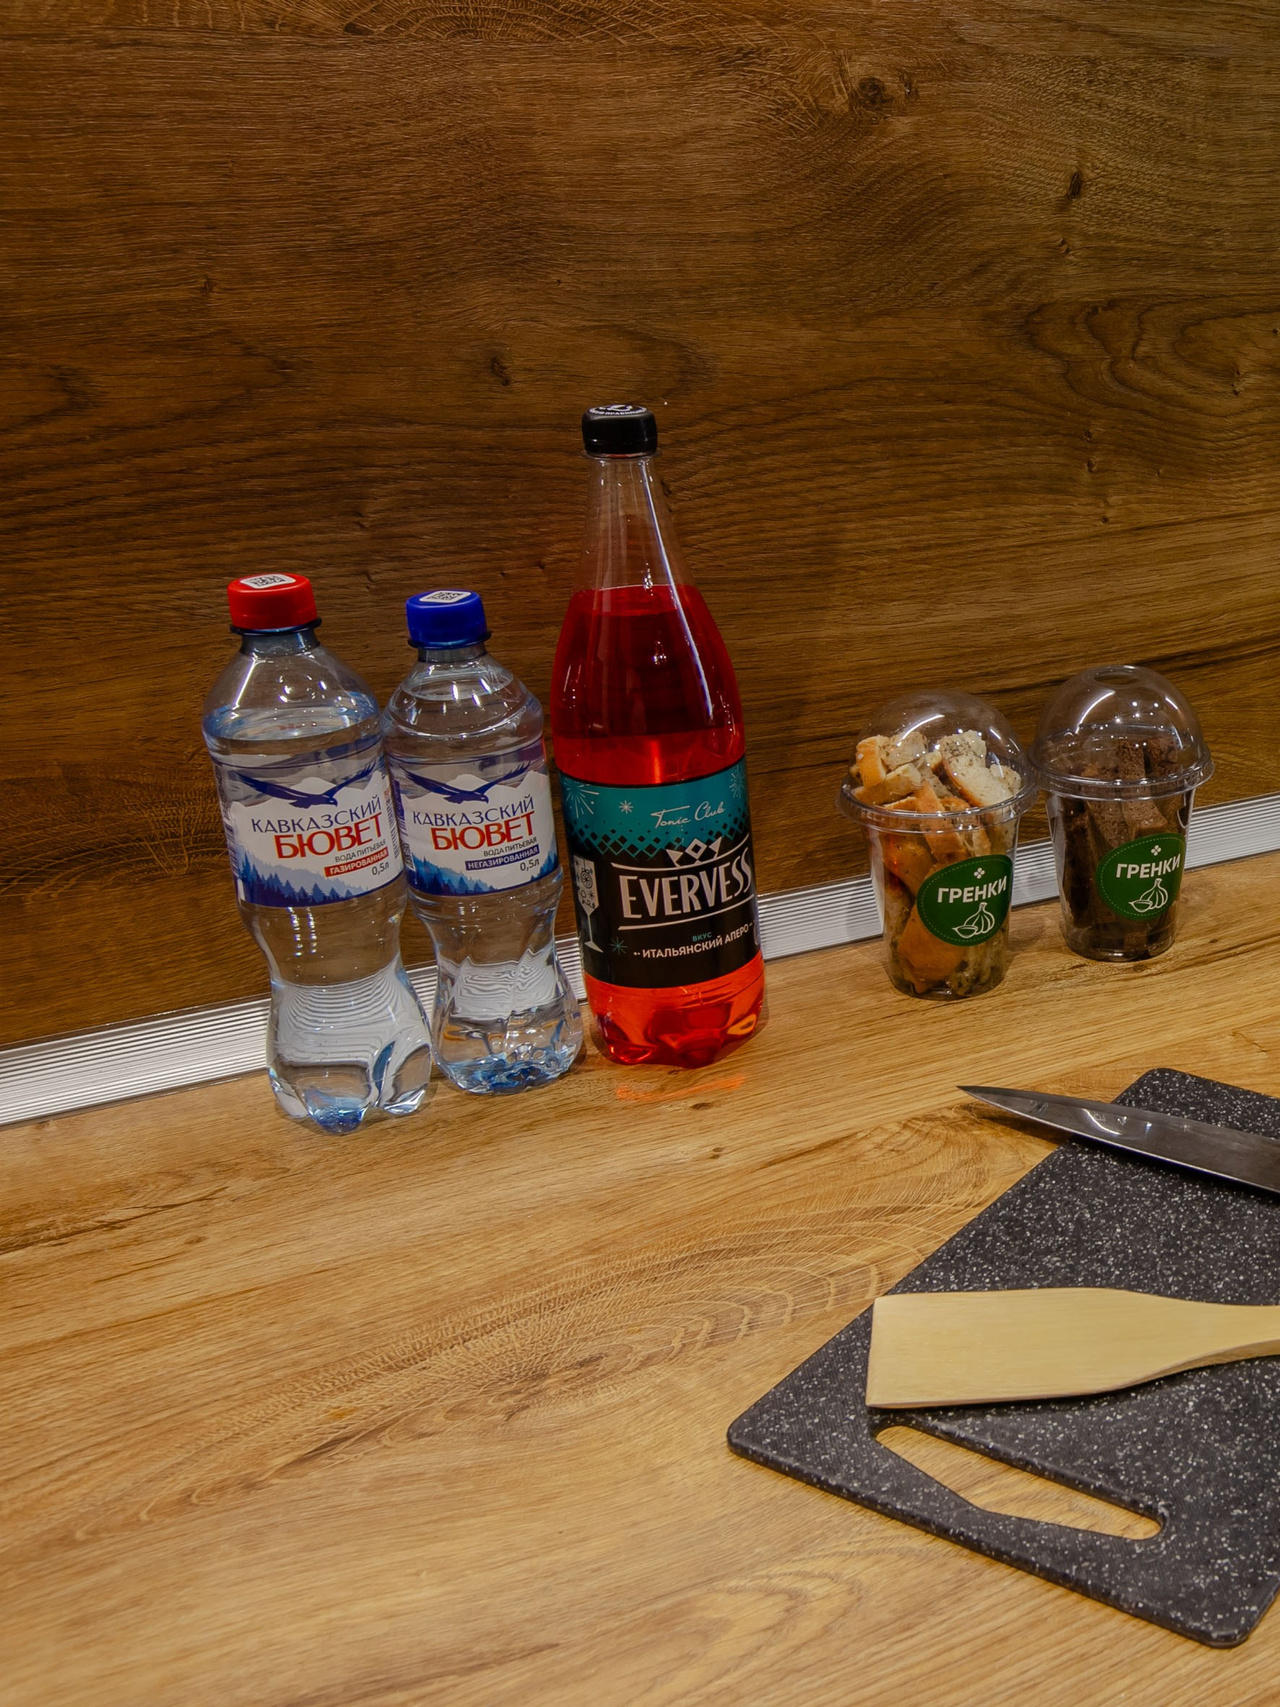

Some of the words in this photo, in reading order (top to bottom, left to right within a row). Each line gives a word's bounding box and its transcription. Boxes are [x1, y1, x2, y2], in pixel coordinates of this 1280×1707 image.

[251, 794, 382, 834] КАВКАЗСКИЙ
[413, 794, 535, 827] КАВКАЗСКИЙ
[651, 805, 691, 829] Tonic
[694, 801, 726, 821] Club
[274, 812, 383, 859] БЮВЕТ
[431, 811, 535, 850] БЮВЕТ
[334, 852, 356, 863] ВОДА
[356, 838, 387, 857] ПИТЬЕВАЯ
[467, 847, 539, 870] НЕГАЗИРОВАННАЯ
[483, 846, 504, 857] ВОДА
[505, 836, 538, 853] ПИТЬЕВАЯ
[329, 849, 388, 875] ГАЗИРОВАННАЯ
[519, 859, 540, 872] 0,5л
[1116, 853, 1181, 880] ГРЕНКИ
[619, 847, 752, 919] EVERVESS
[937, 875, 1007, 904] ГРЕНКИ
[642, 935, 723, 959] ИТАЛЬЯНСКИЙ
[724, 924, 749, 944] АПЕРО
[692, 931, 713, 942] ВКУС
